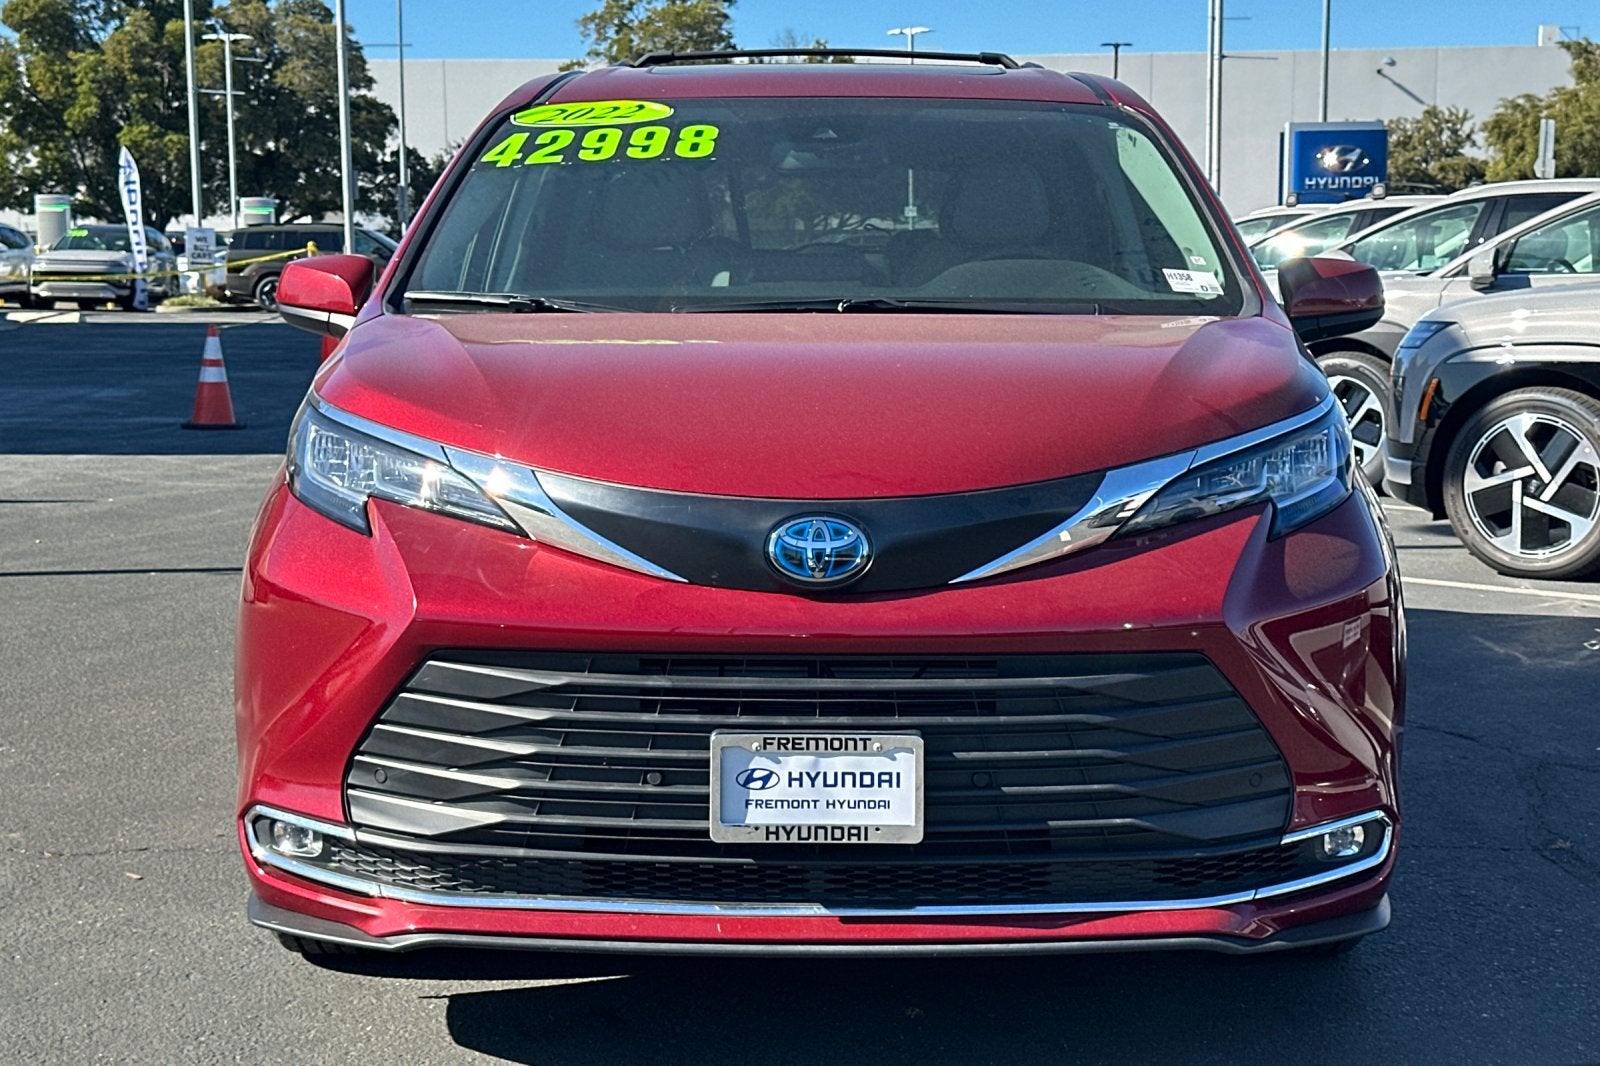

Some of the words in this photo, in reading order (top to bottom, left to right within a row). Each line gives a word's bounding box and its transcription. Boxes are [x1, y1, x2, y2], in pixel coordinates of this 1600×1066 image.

[538, 104, 645, 122] 2022
[480, 125, 719, 168] 42998
[762, 737, 872, 751] FREMONT
[787, 771, 901, 788] HYUNDAI
[745, 799, 820, 809] FREMONT
[826, 799, 890, 810] HYUNDAI
[765, 826, 869, 841] HYUNDAI
